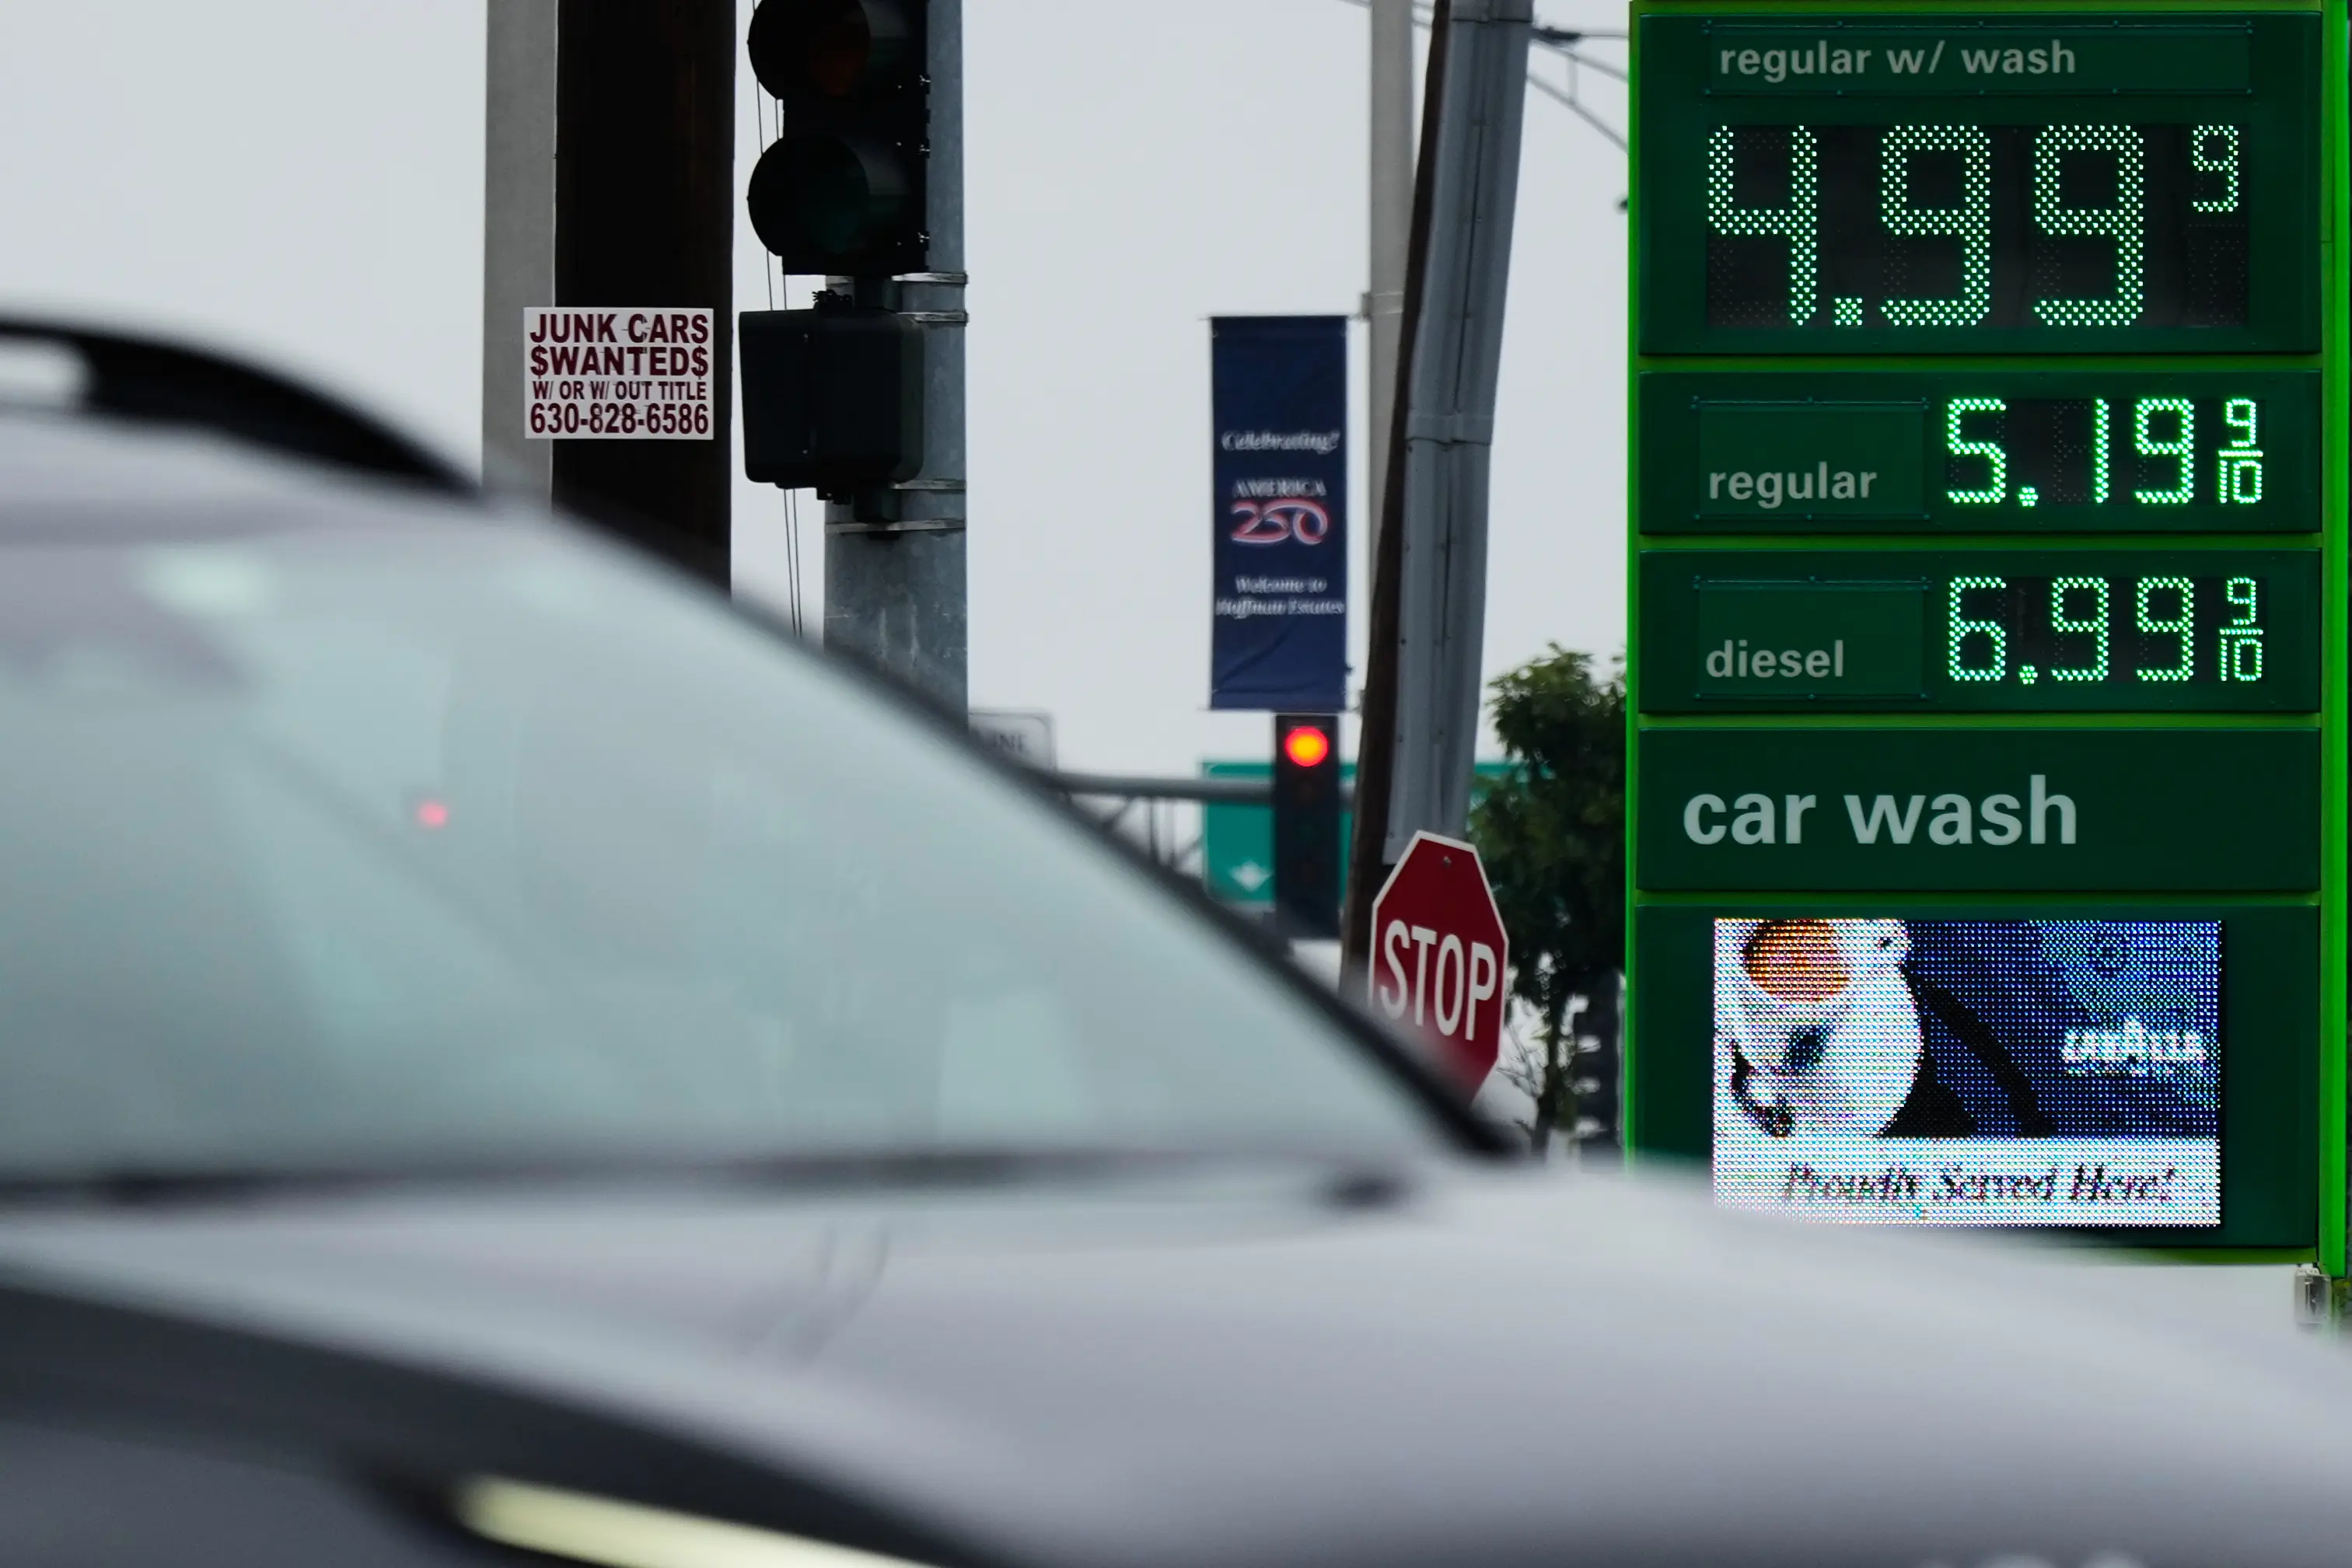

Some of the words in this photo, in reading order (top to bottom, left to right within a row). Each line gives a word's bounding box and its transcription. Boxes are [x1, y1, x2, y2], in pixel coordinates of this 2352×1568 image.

[1719, 40, 1871, 83] regular
[1886, 40, 1946, 75] w/
[1961, 40, 2077, 75] wash
[1708, 125, 2144, 327] 4.99
[530, 314, 617, 343] JUNK
[627, 313, 709, 344] CARS
[530, 345, 709, 379] $WANTED$
[533, 381, 553, 400] W/
[559, 381, 585, 400] OR
[658, 381, 707, 400] TITLE
[530, 403, 709, 434] 630-828-6586
[1710, 462, 1877, 509] regular
[1948, 398, 2194, 506] 5.19
[1233, 479, 1327, 498] AMERICA
[1231, 498, 1331, 545] 250
[1235, 577, 1305, 593] Welcome
[1307, 578, 1328, 593] to
[1216, 598, 1287, 619] Hoffman
[1288, 598, 1345, 615] Estates
[1706, 640, 1844, 679] diesel
[1948, 577, 2194, 684] 6.99
[1683, 793, 1816, 846] car
[1844, 774, 2078, 846] wash
[1380, 919, 1497, 1041] STOP
[1933, 1162, 2057, 1201] Served
[2070, 1162, 2175, 1201] Here!
